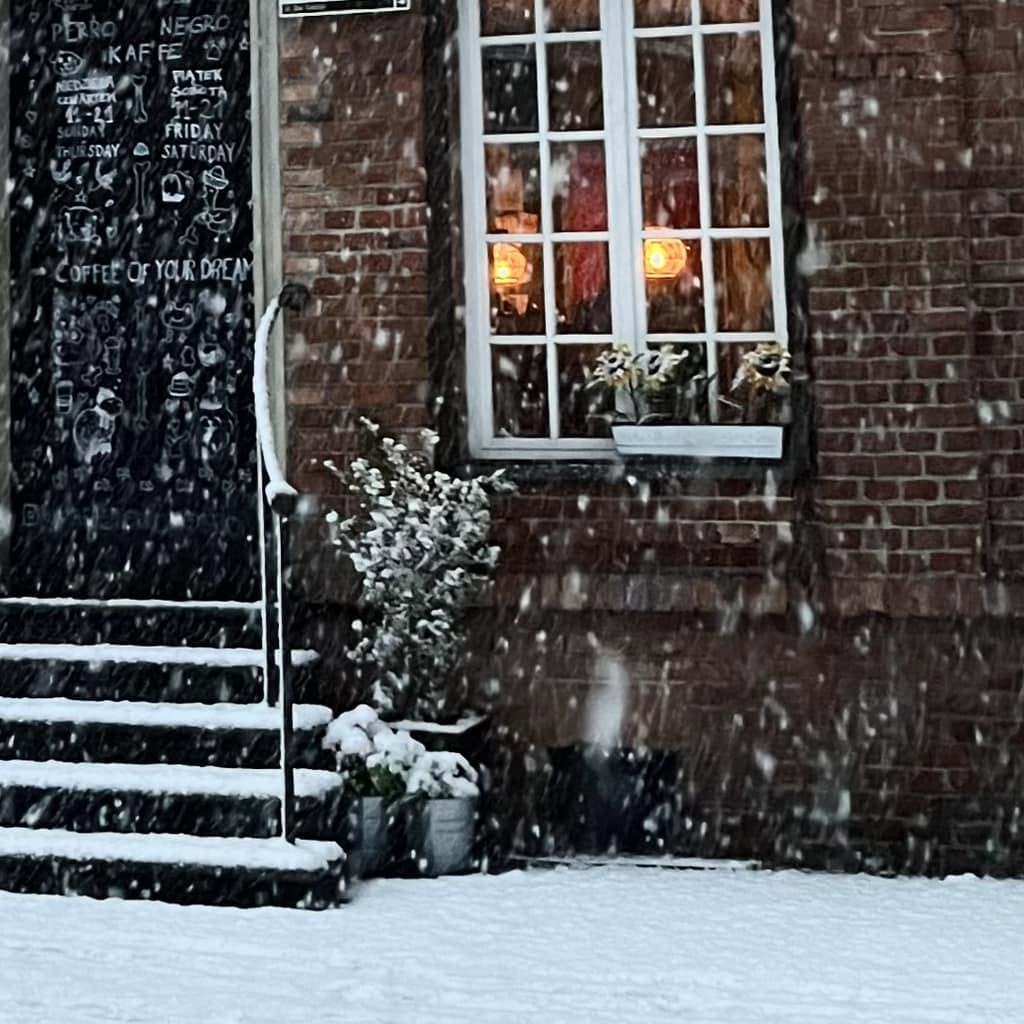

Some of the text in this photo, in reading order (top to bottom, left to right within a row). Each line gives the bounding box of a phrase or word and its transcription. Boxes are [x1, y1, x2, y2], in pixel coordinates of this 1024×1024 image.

[160, 14, 230, 37] NEGRO
[107, 42, 183, 65] KAFFE
[165, 122, 224, 141] FRIDAY
[161, 142, 235, 163] SATURDAY
[55, 262, 122, 284] COFFEE
[127, 261, 151, 284] OF
[155, 258, 196, 282] YOUR
